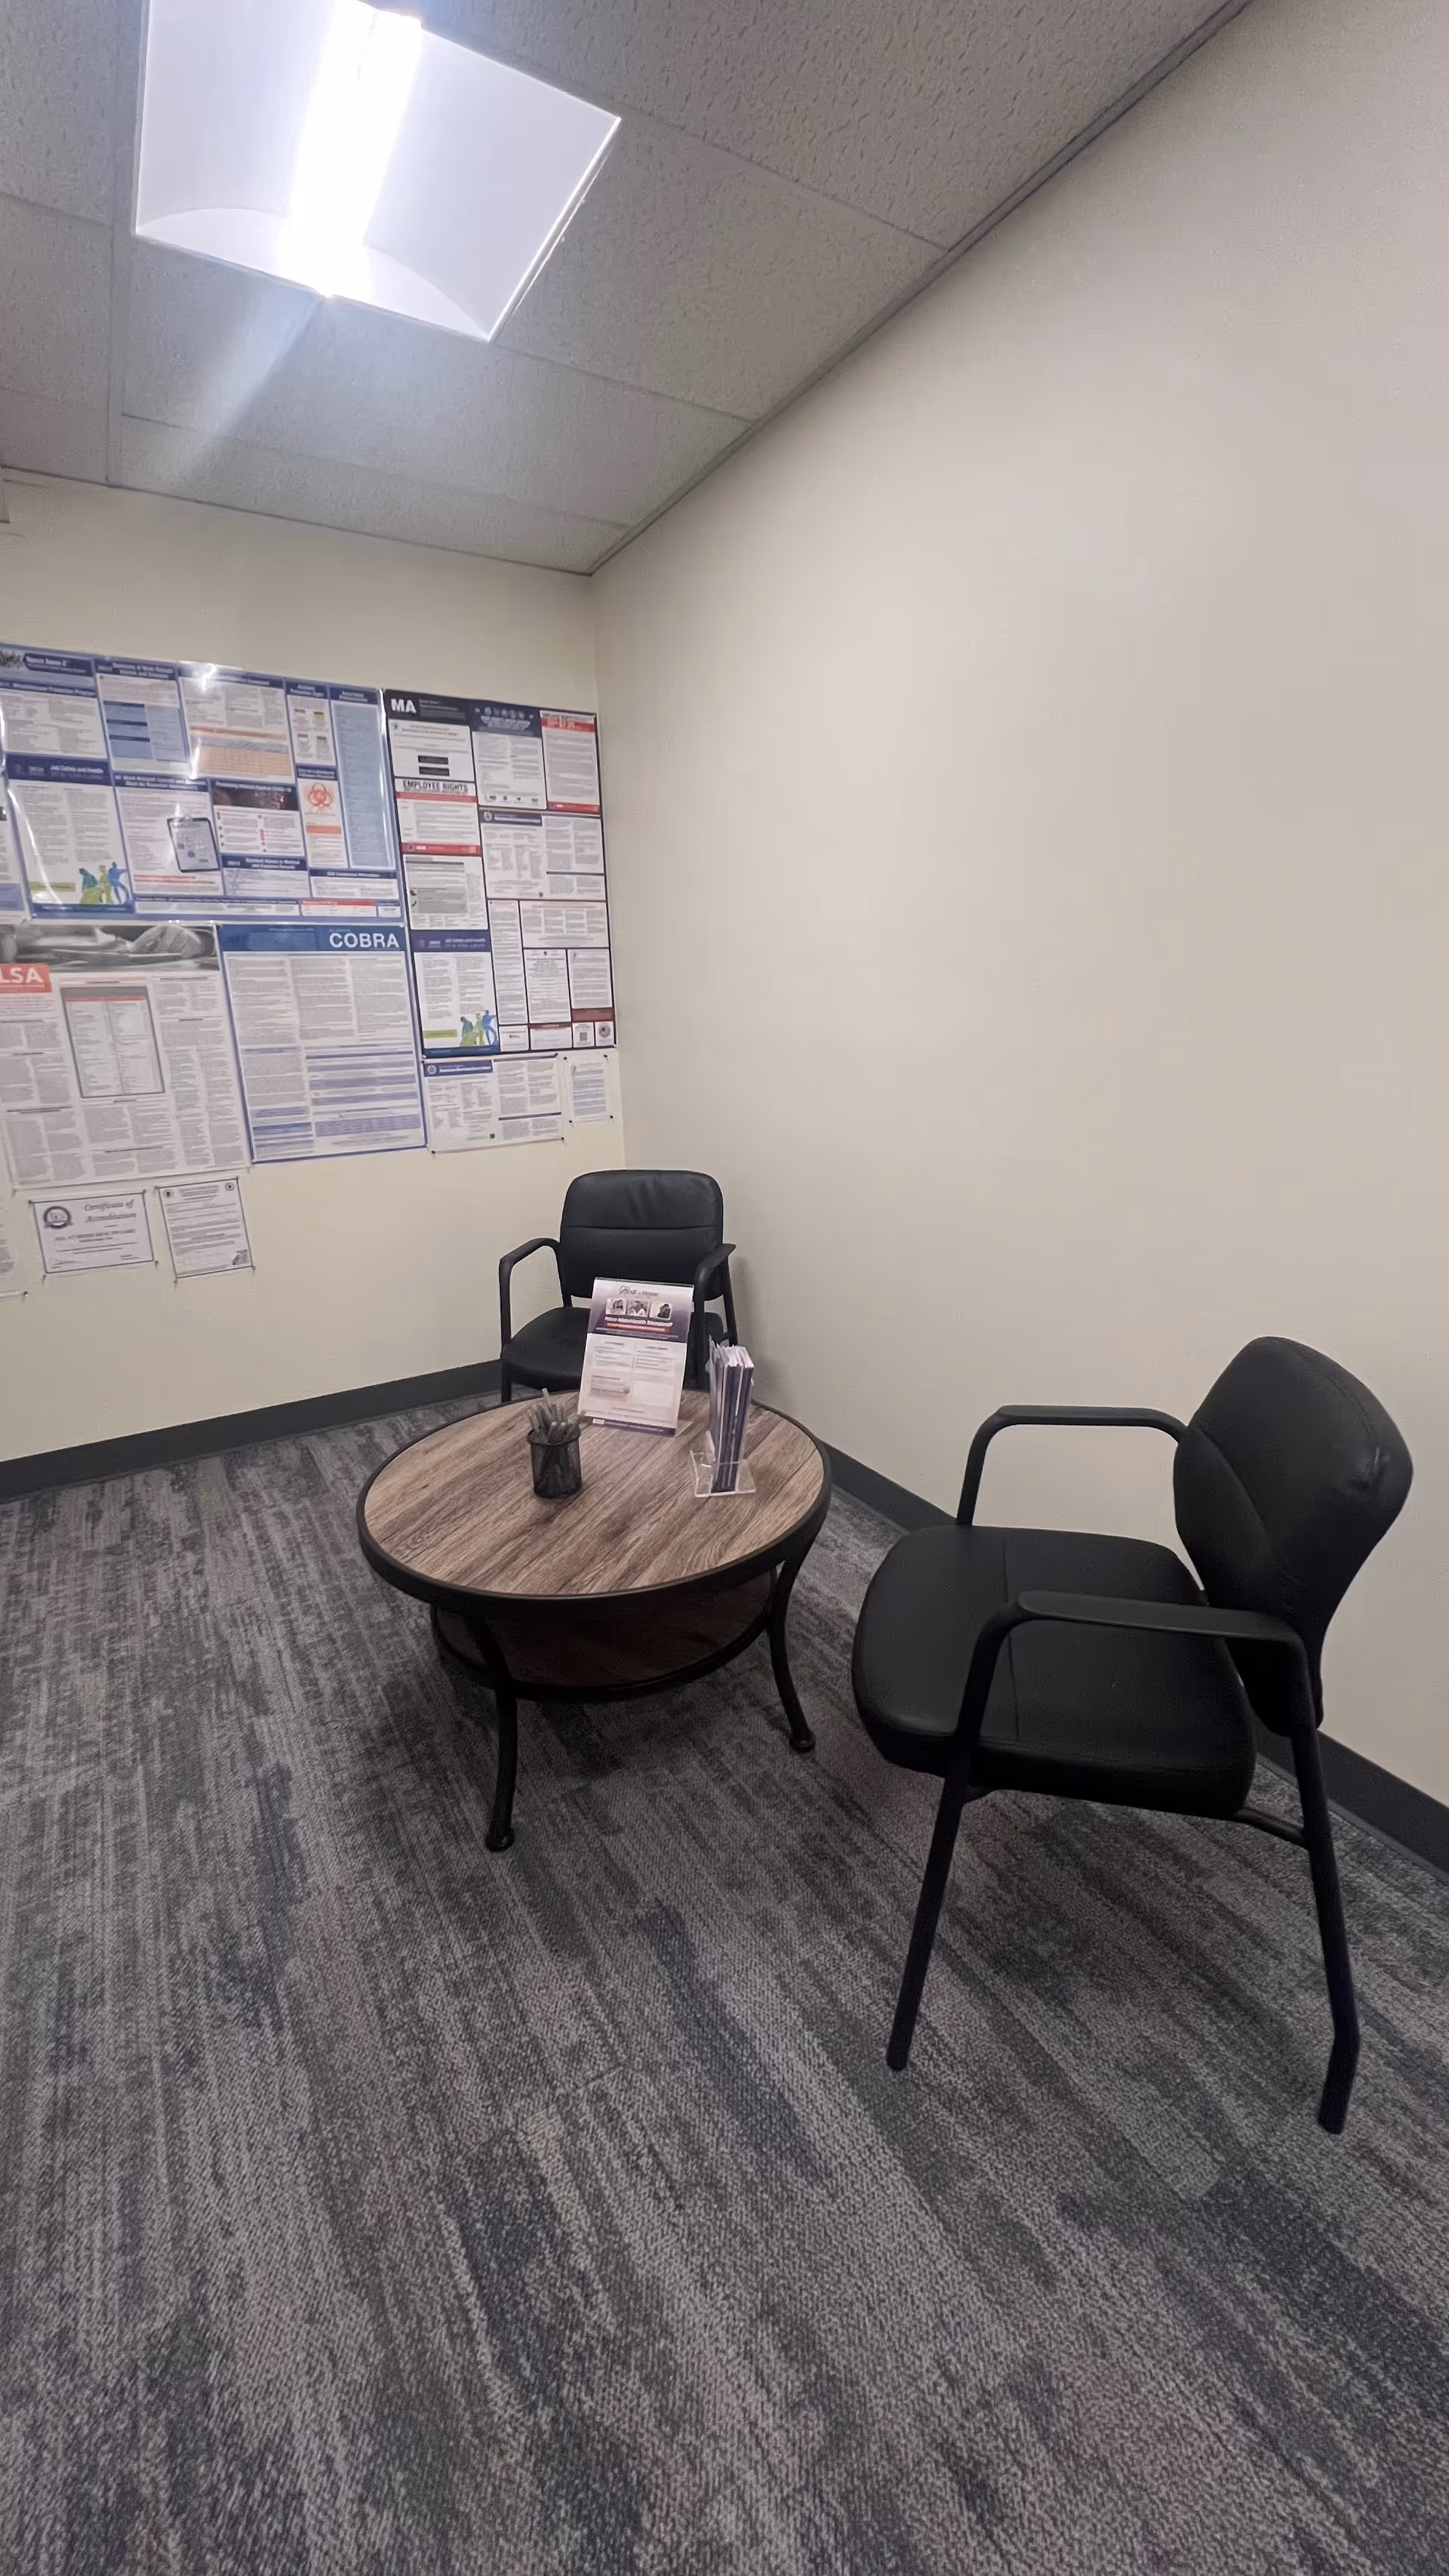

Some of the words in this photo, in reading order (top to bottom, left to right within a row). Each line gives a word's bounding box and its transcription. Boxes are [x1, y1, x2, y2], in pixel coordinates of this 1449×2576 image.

[390, 698, 417, 714] MA
[402, 780, 440, 791] EMPLOYEE
[442, 783, 468, 792] RIGHTS
[329, 932, 400, 948] COBRA
